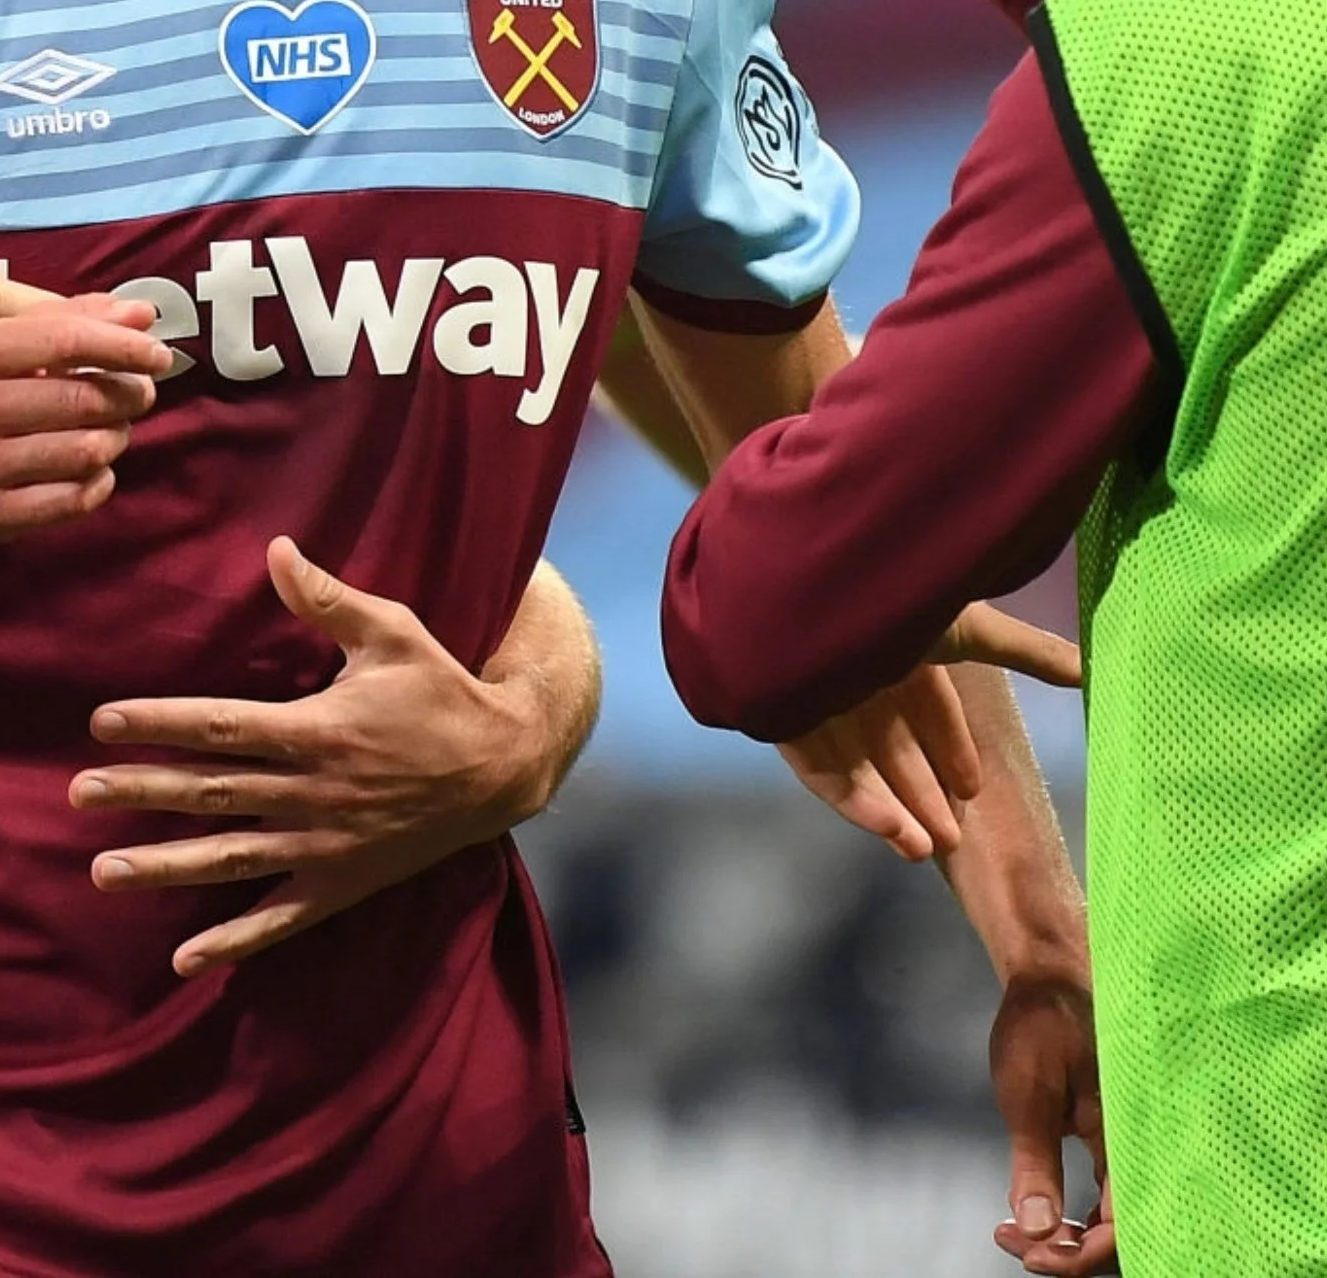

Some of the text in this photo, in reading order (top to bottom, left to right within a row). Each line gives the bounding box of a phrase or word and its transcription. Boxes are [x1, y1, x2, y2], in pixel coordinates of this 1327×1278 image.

[255, 37, 342, 78] NHS
[7, 106, 111, 139] umbro
[518, 107, 565, 126] LONDON
